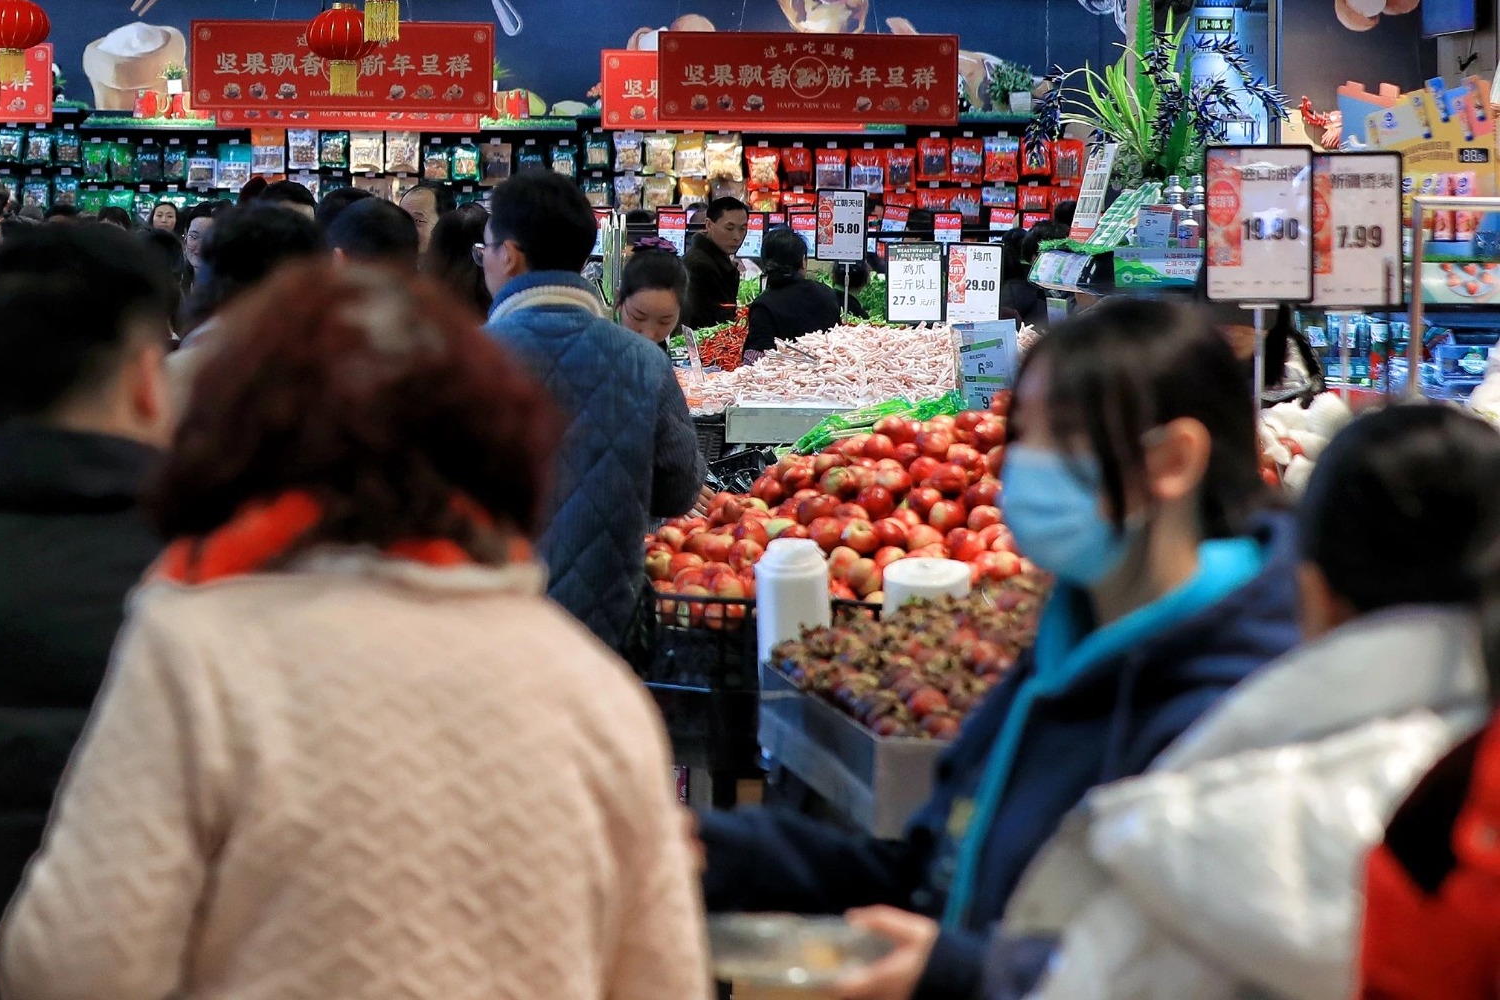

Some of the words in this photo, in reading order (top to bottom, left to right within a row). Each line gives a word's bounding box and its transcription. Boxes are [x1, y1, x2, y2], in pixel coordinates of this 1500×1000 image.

[764, 42, 855, 60] 过年吃坚果
[360, 53, 473, 78] 新年呈祥
[681, 64, 789, 90] 坚果飘香
[827, 65, 938, 90] 新年呈祥
[833, 223, 860, 235] 15.80
[1336, 225, 1383, 248] 7.99
[972, 252, 992, 262] 鸡爪
[902, 264, 926, 275] 鸡爪
[891, 279, 937, 290] 三斤以上
[965, 279, 996, 291] 29.90
[892, 295, 916, 306] 27.9
